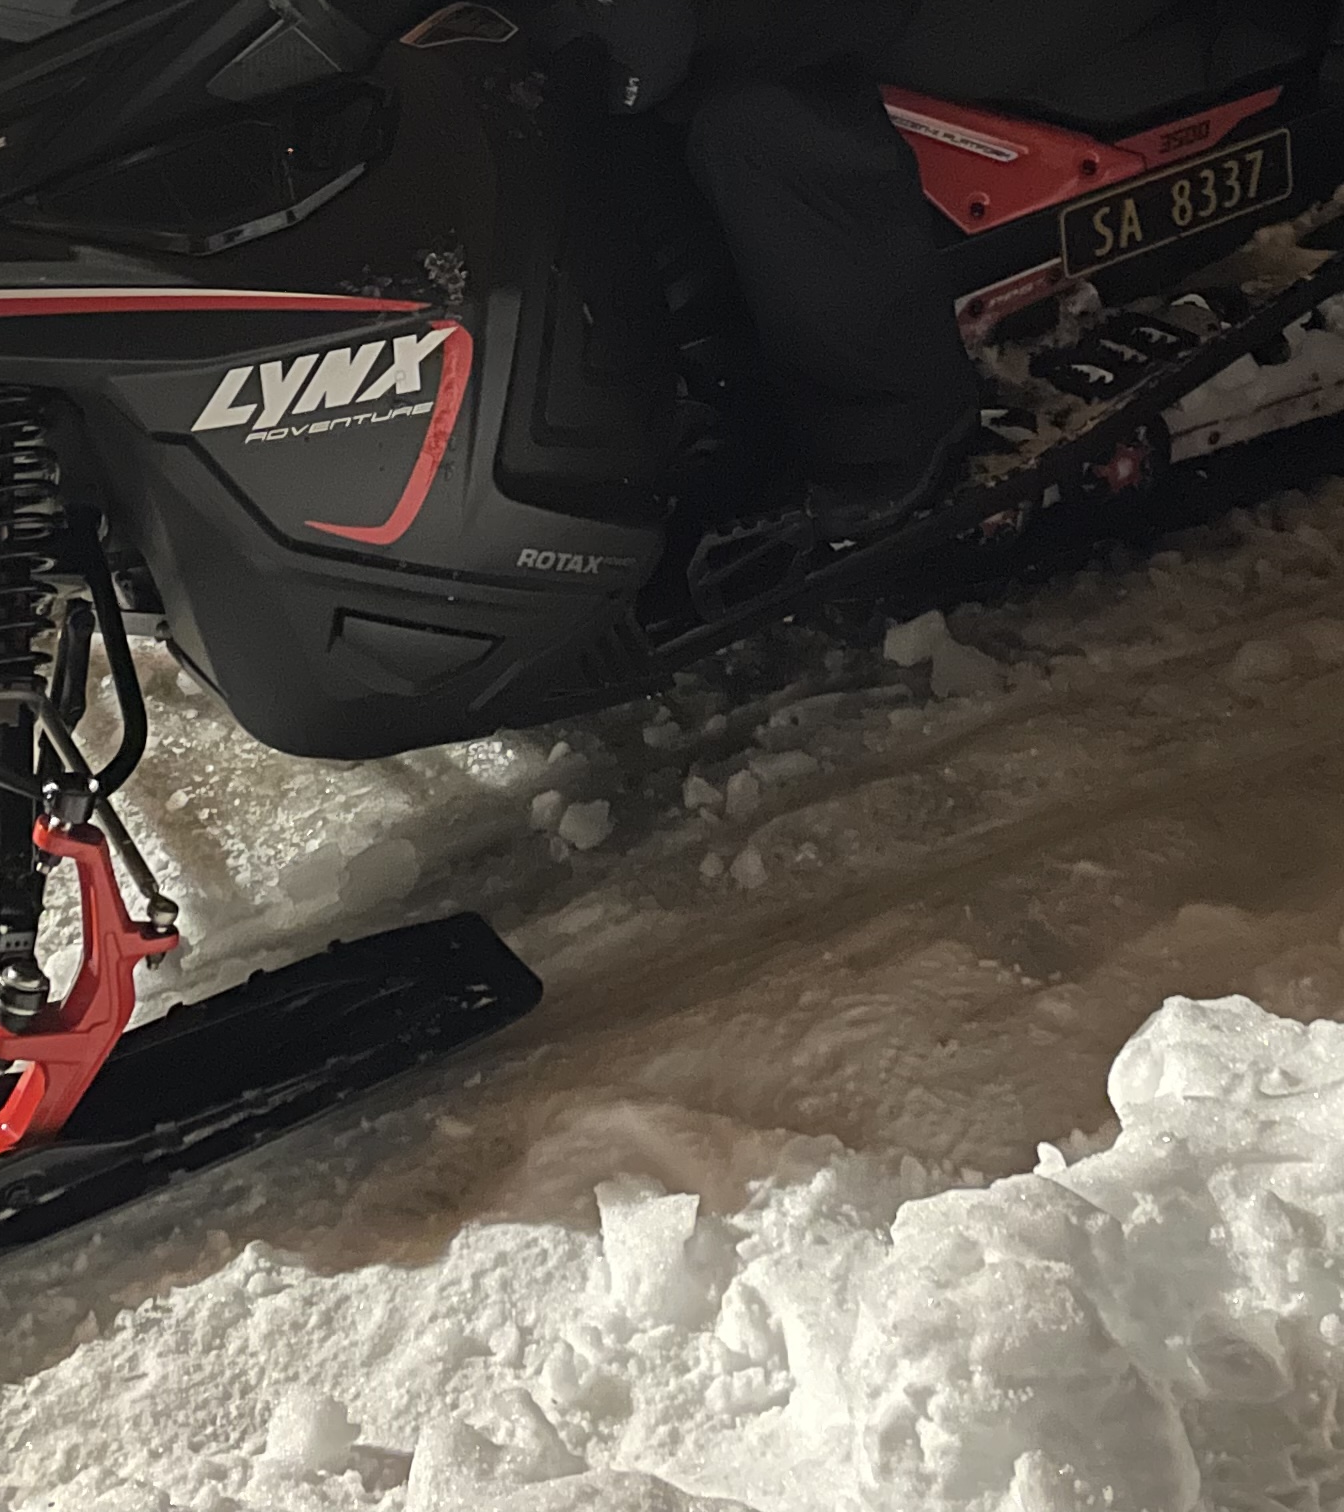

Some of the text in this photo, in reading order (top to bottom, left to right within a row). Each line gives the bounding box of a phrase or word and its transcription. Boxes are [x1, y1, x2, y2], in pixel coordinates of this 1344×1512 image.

[1092, 149, 1264, 257] SA 8337
[190, 326, 457, 432] LYNX
[244, 401, 434, 444] ADVENTURE
[516, 548, 604, 574] ROTAX
